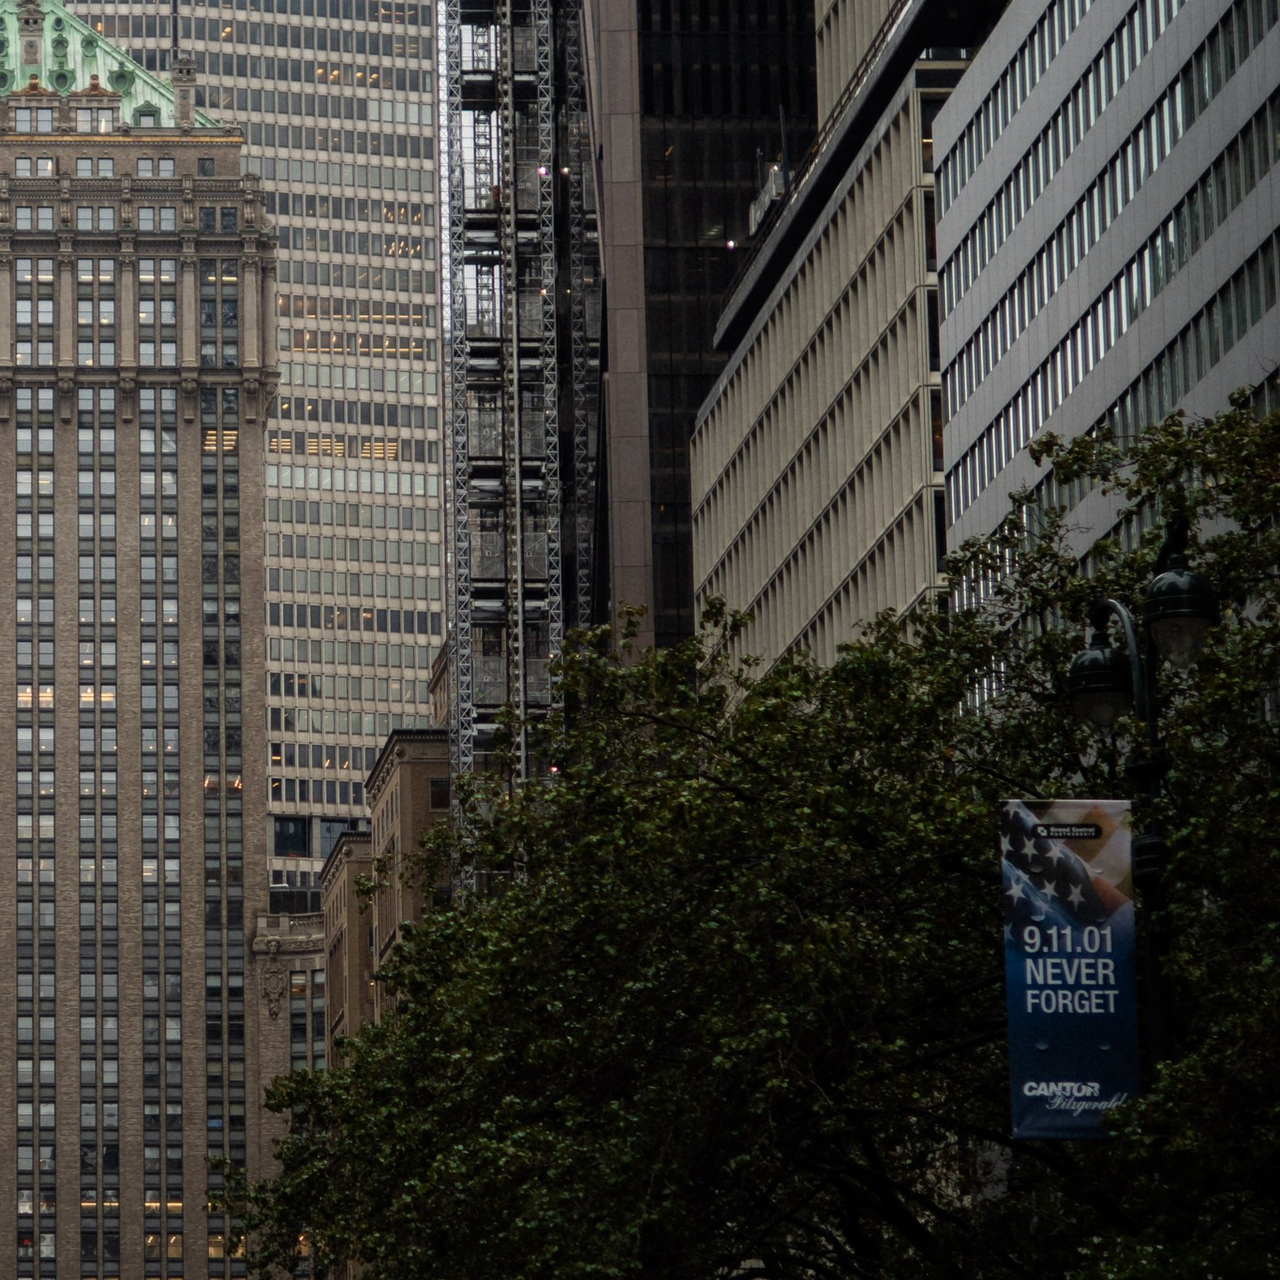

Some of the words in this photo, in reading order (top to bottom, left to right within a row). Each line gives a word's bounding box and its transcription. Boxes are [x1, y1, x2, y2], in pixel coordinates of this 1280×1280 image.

[1023, 925, 1113, 954] 9.11.01
[1025, 958, 1116, 985] NEVER
[1026, 989, 1119, 1014] FORGET
[1023, 1082, 1100, 1097] CANTOR
